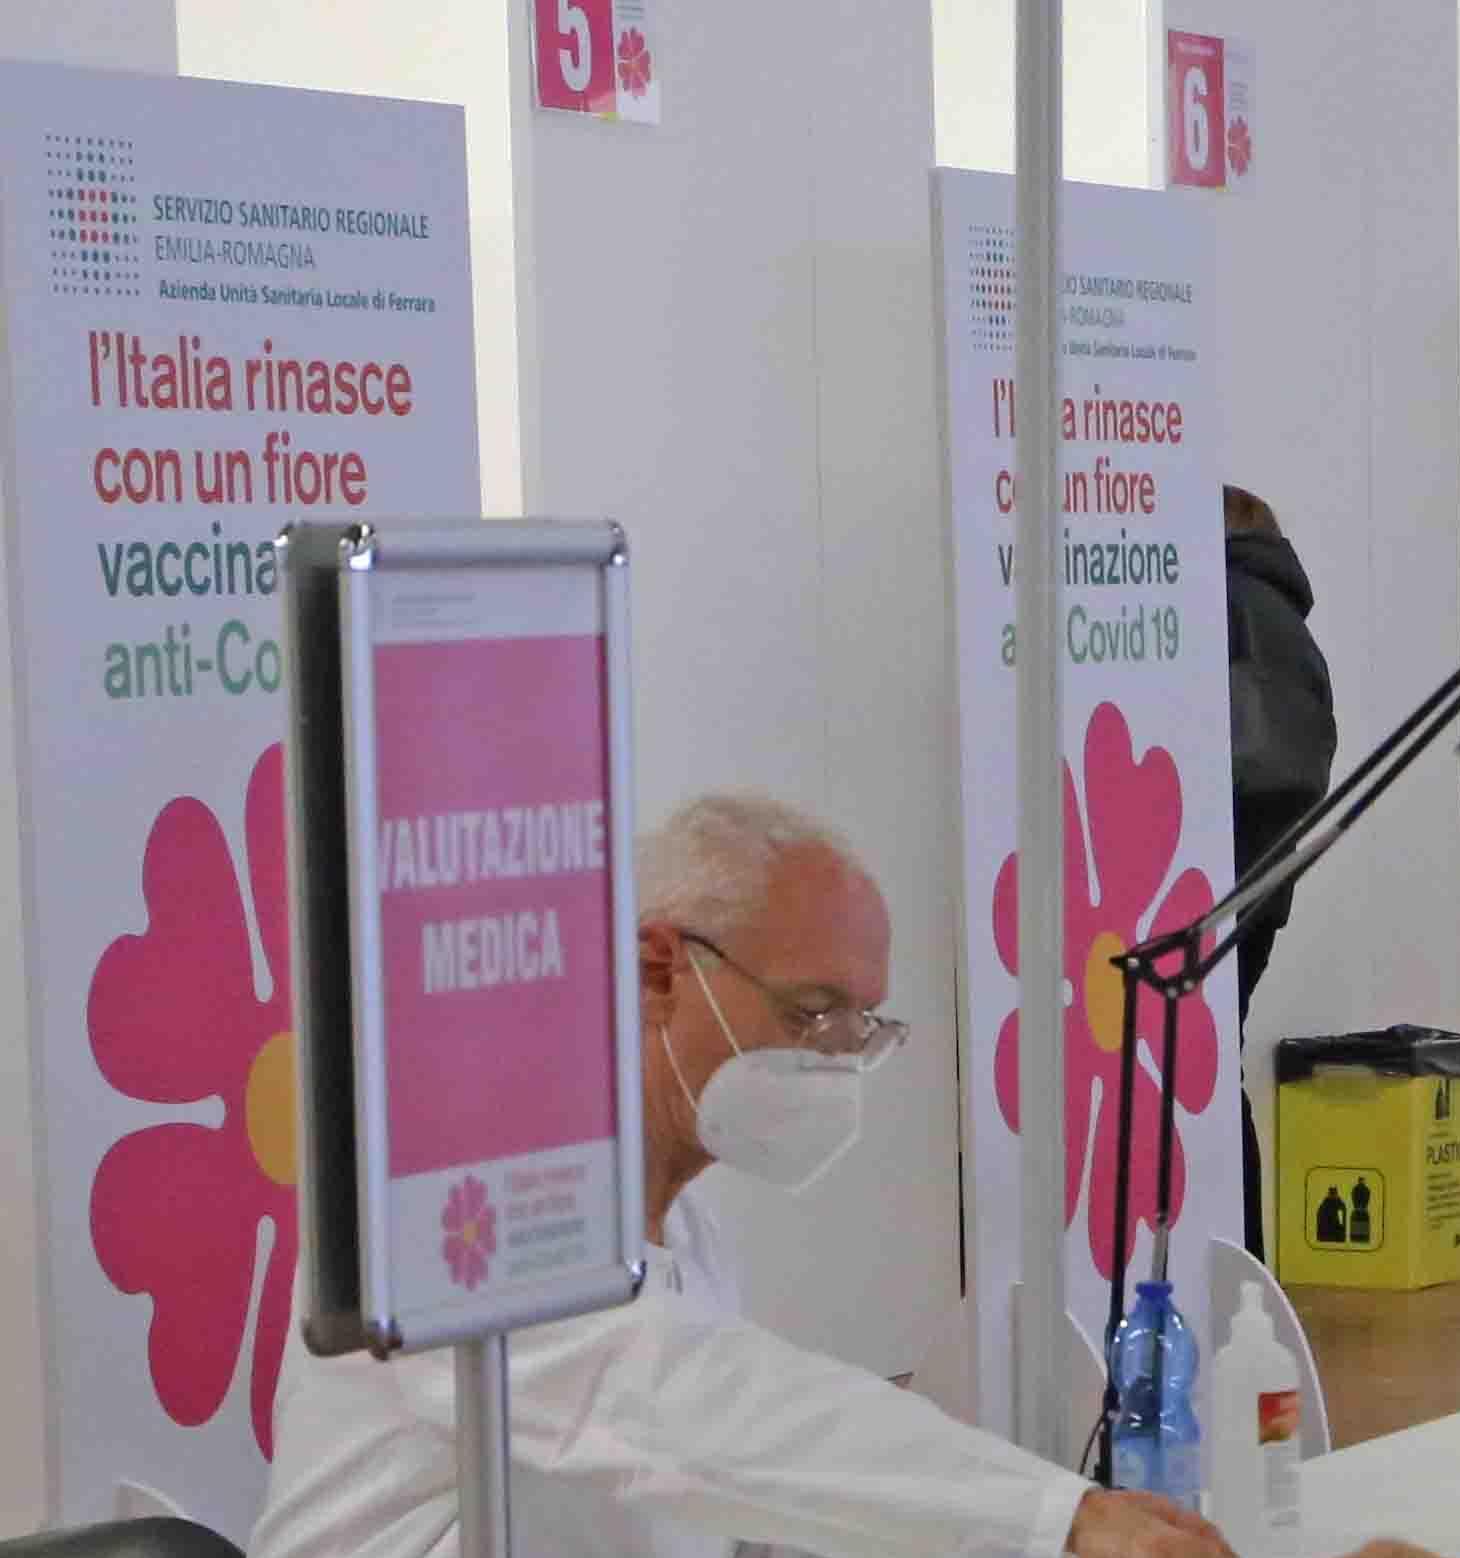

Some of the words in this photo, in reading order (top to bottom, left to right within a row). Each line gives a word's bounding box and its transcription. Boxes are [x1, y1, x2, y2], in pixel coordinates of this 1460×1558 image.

[558, 0, 592, 91] 5
[1184, 64, 1209, 171] 6
[152, 194, 234, 225] SERVIZIO
[239, 200, 330, 233] SANITARIO
[335, 208, 430, 240] REGIONALE
[155, 234, 316, 270] EMILIA-ROMAGNA
[159, 280, 217, 301] Azienda
[263, 284, 323, 307] Sanitaria
[327, 289, 369, 310] Locale
[388, 292, 436, 313] Ferrara
[89, 330, 233, 411] l'Italia
[246, 336, 413, 417] rinasce
[1084, 383, 1184, 444] rinasce
[94, 447, 184, 504] con
[195, 449, 253, 504] un
[263, 430, 368, 506] fiore
[1094, 455, 1156, 514] fiore
[98, 519, 278, 597] vaccina
[998, 528, 1180, 587] vinazione
[104, 619, 282, 699] anti-Co
[1152, 604, 1181, 660] 19
[423, 910, 568, 994] MEDICA
